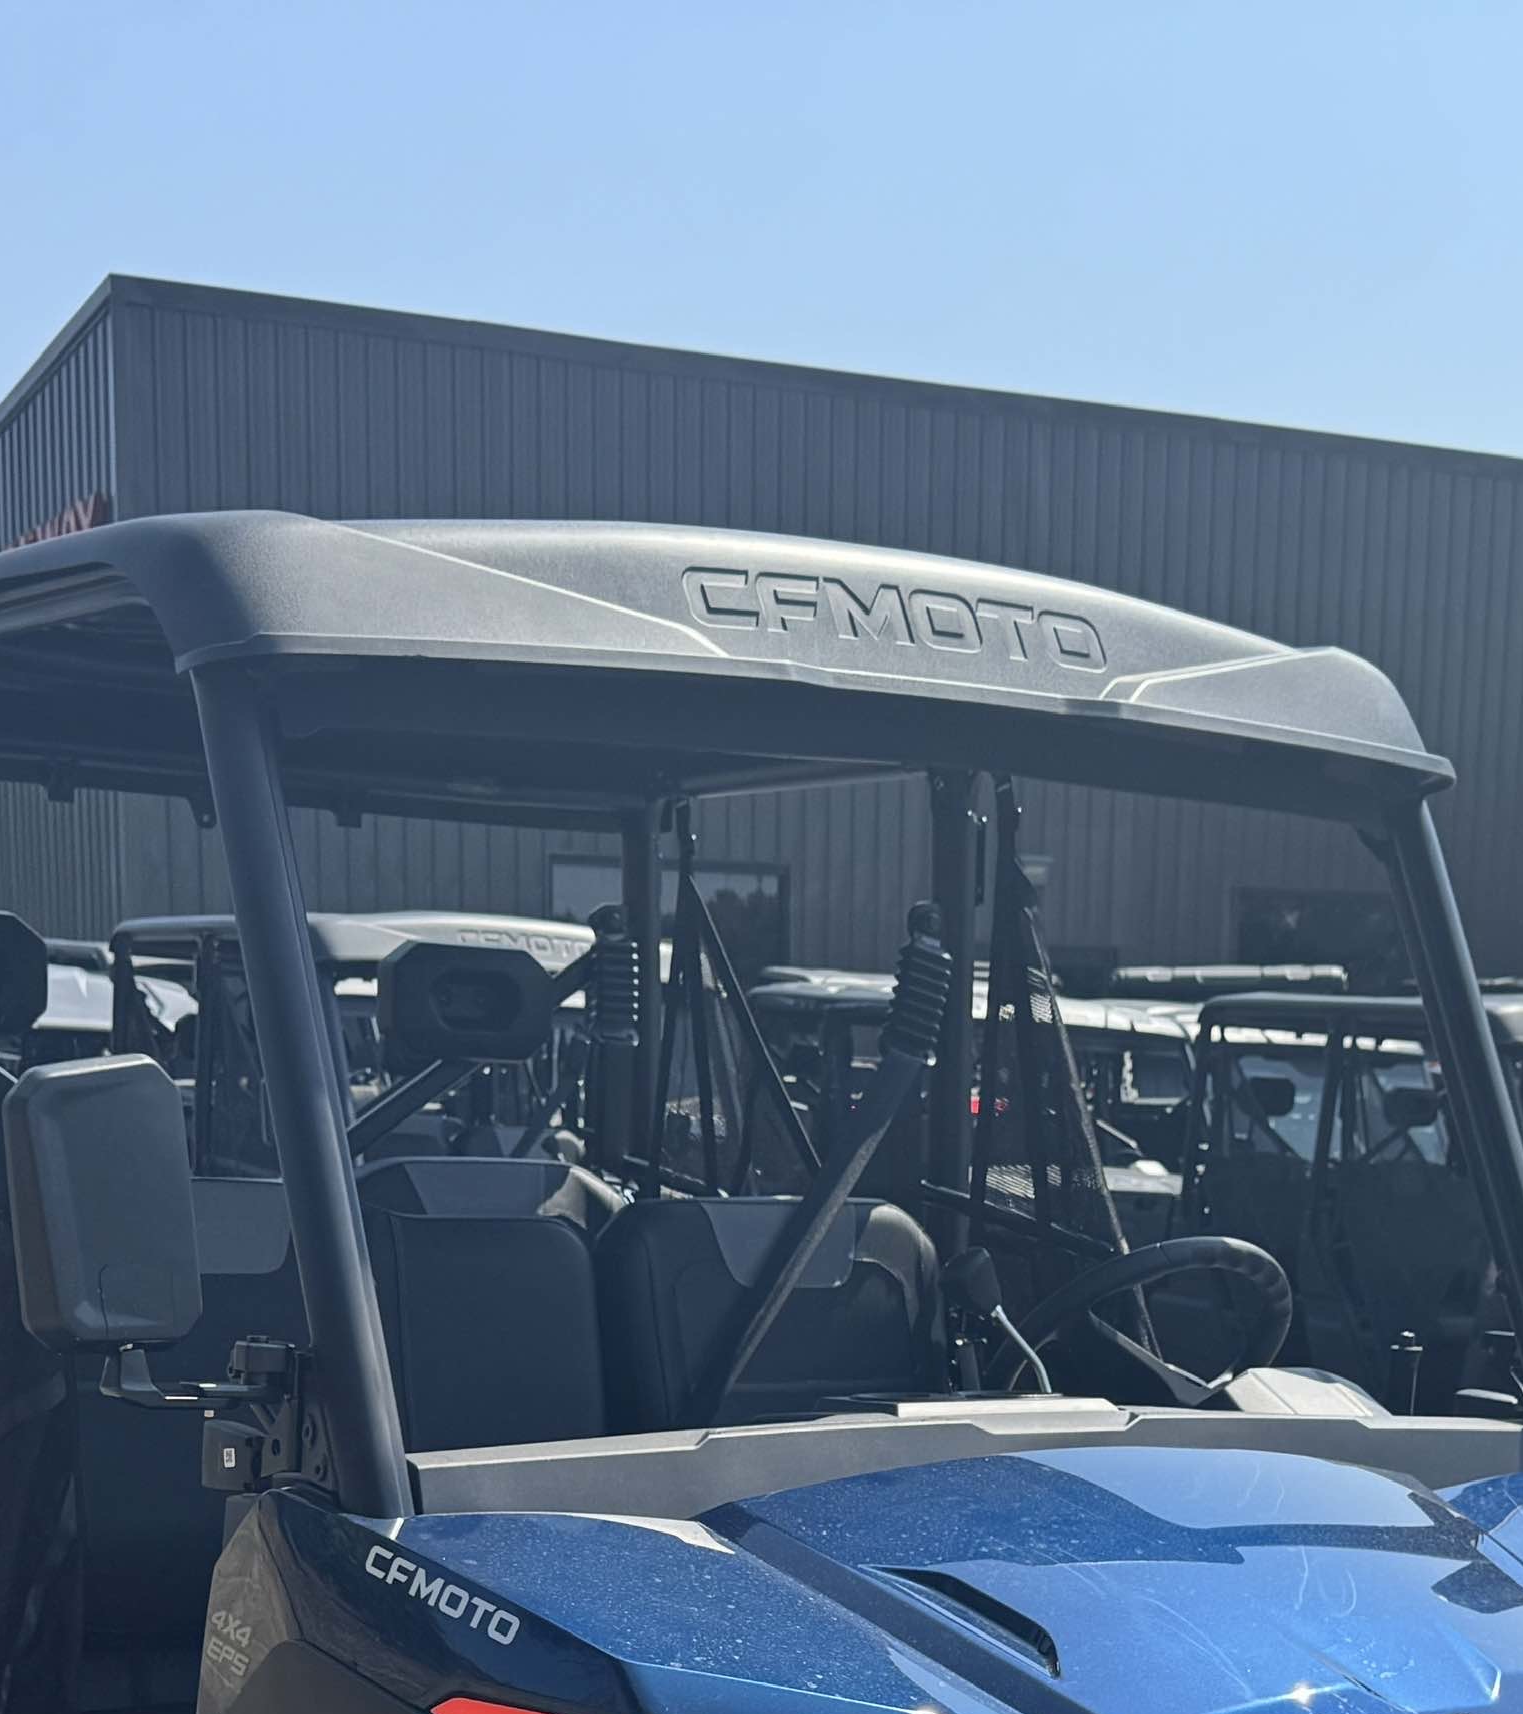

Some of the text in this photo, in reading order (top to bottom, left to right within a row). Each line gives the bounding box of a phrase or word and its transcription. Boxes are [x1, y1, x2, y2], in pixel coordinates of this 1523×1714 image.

[681, 566, 1108, 673] CFMOTO
[211, 1610, 252, 1648] 4X4
[365, 1545, 521, 1646] CFMOTO
[207, 1636, 249, 1676] EPS
